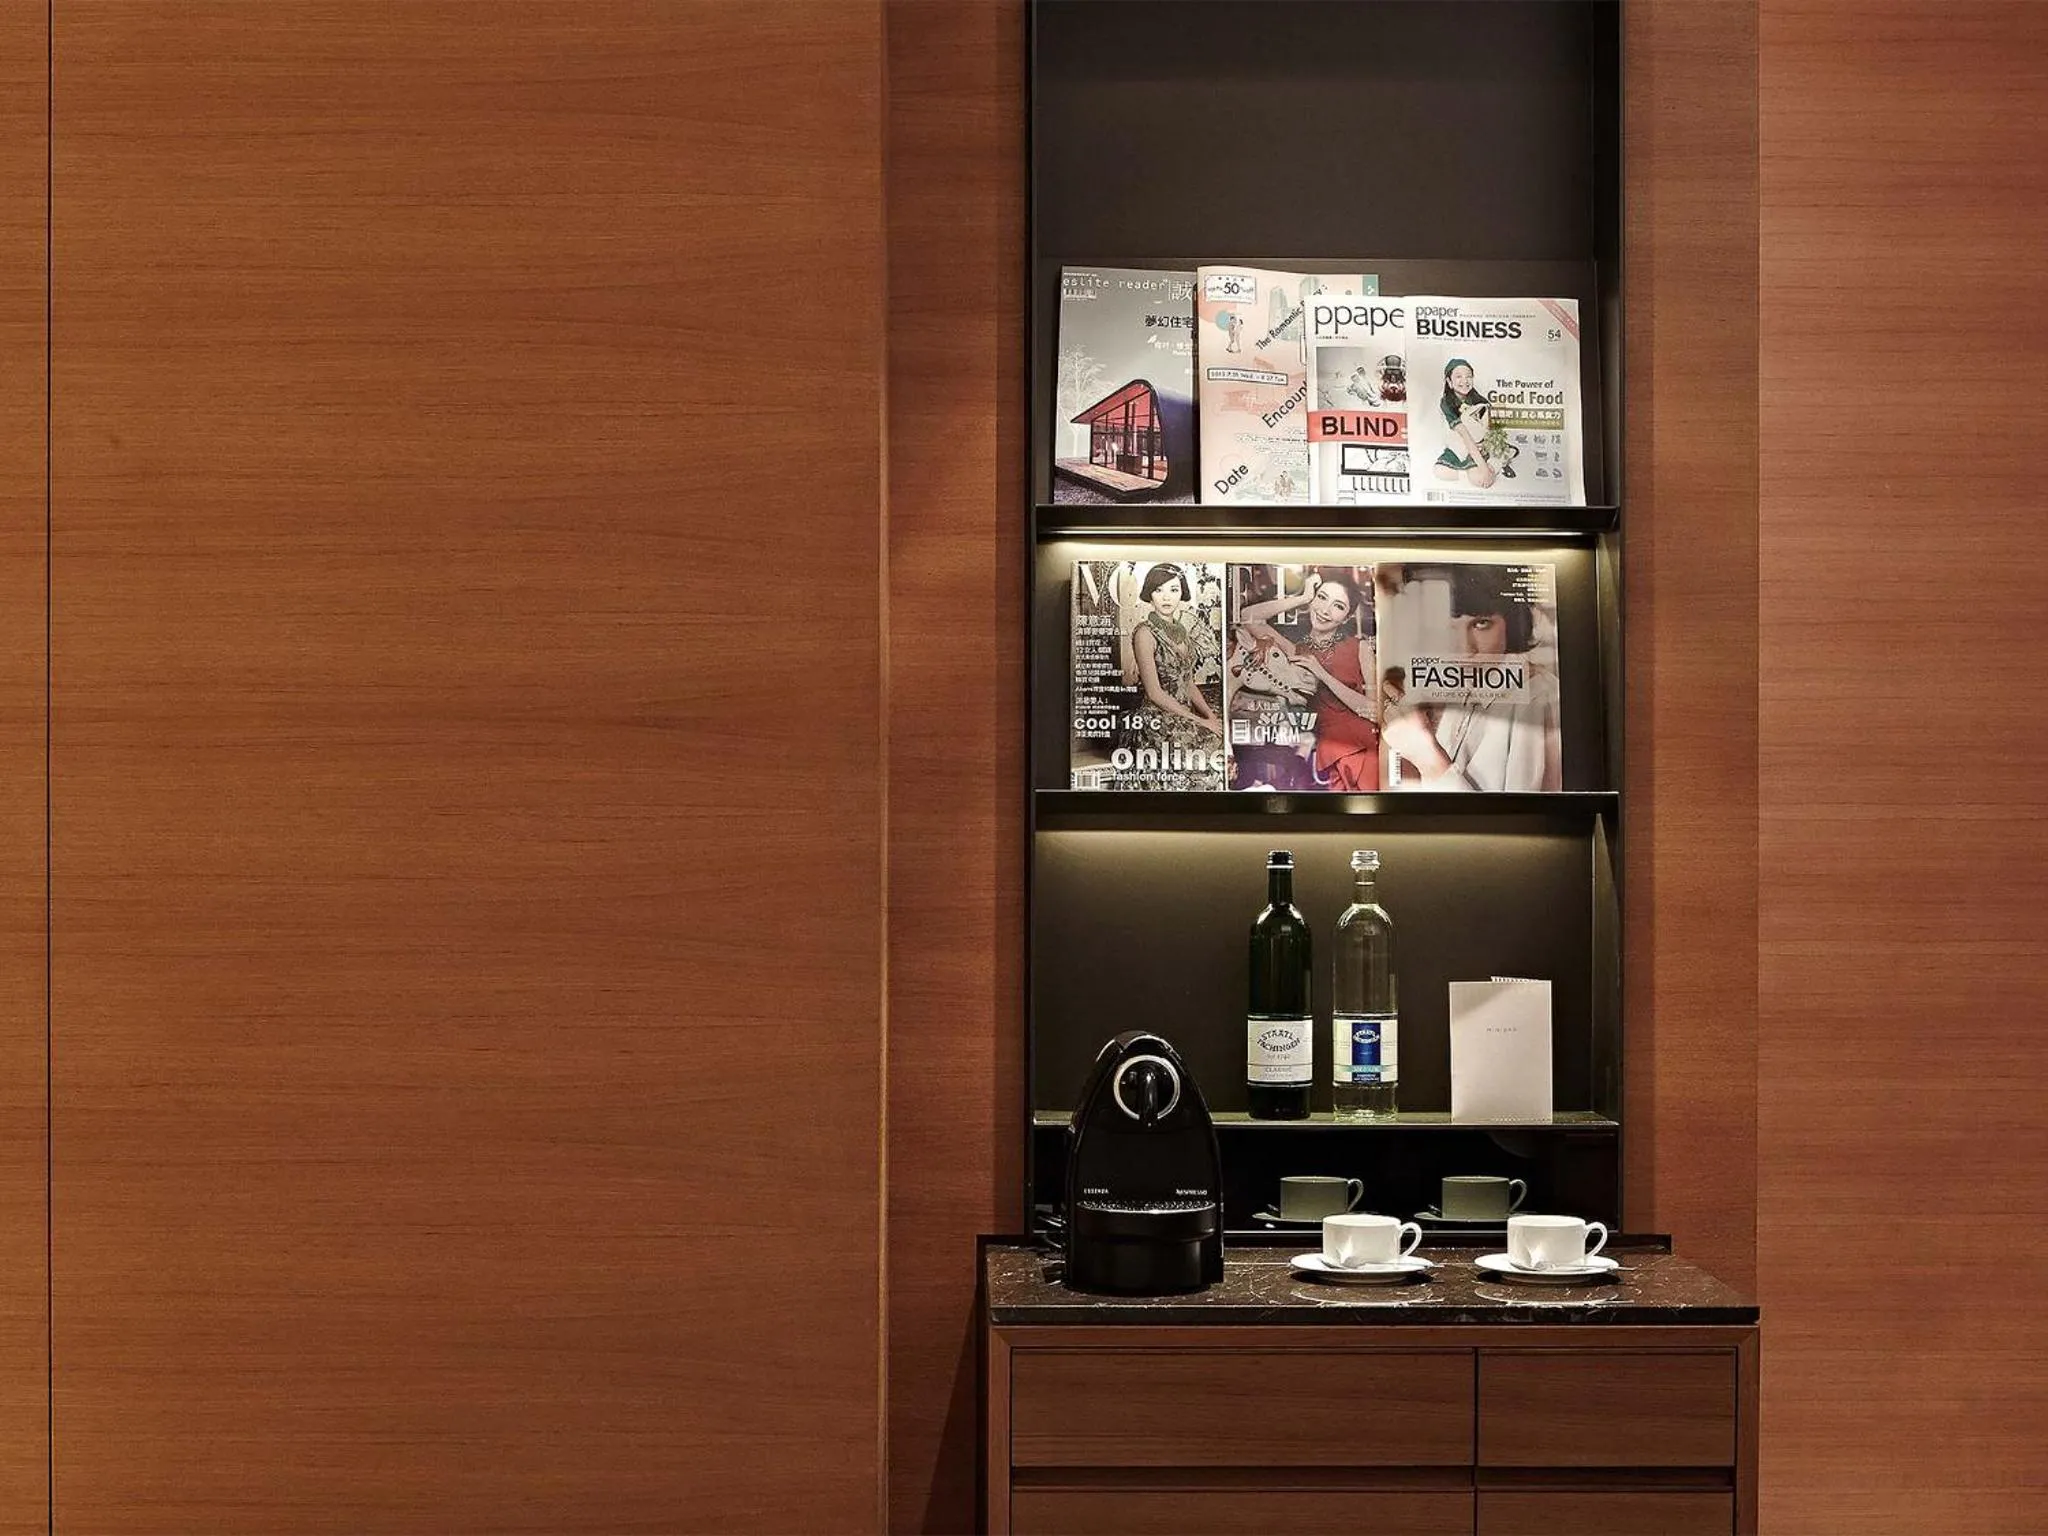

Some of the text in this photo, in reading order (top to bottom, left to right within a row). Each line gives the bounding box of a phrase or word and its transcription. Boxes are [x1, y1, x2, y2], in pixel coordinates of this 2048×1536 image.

[1063, 277, 1166, 290] eslite reader
[1416, 306, 1459, 320] ppaper
[1416, 319, 1522, 339] BUSINESS
[1547, 329, 1561, 339] 54
[1496, 379, 1513, 387] The
[1544, 380, 1553, 388] of
[1488, 390, 1563, 404] Good Food
[1322, 416, 1398, 437] BLIND
[1214, 465, 1249, 494] Date
[1412, 667, 1523, 688] FASHION
[1074, 715, 1116, 730] cool
[1254, 725, 1300, 743] CHARM
[1111, 741, 1224, 771] online
